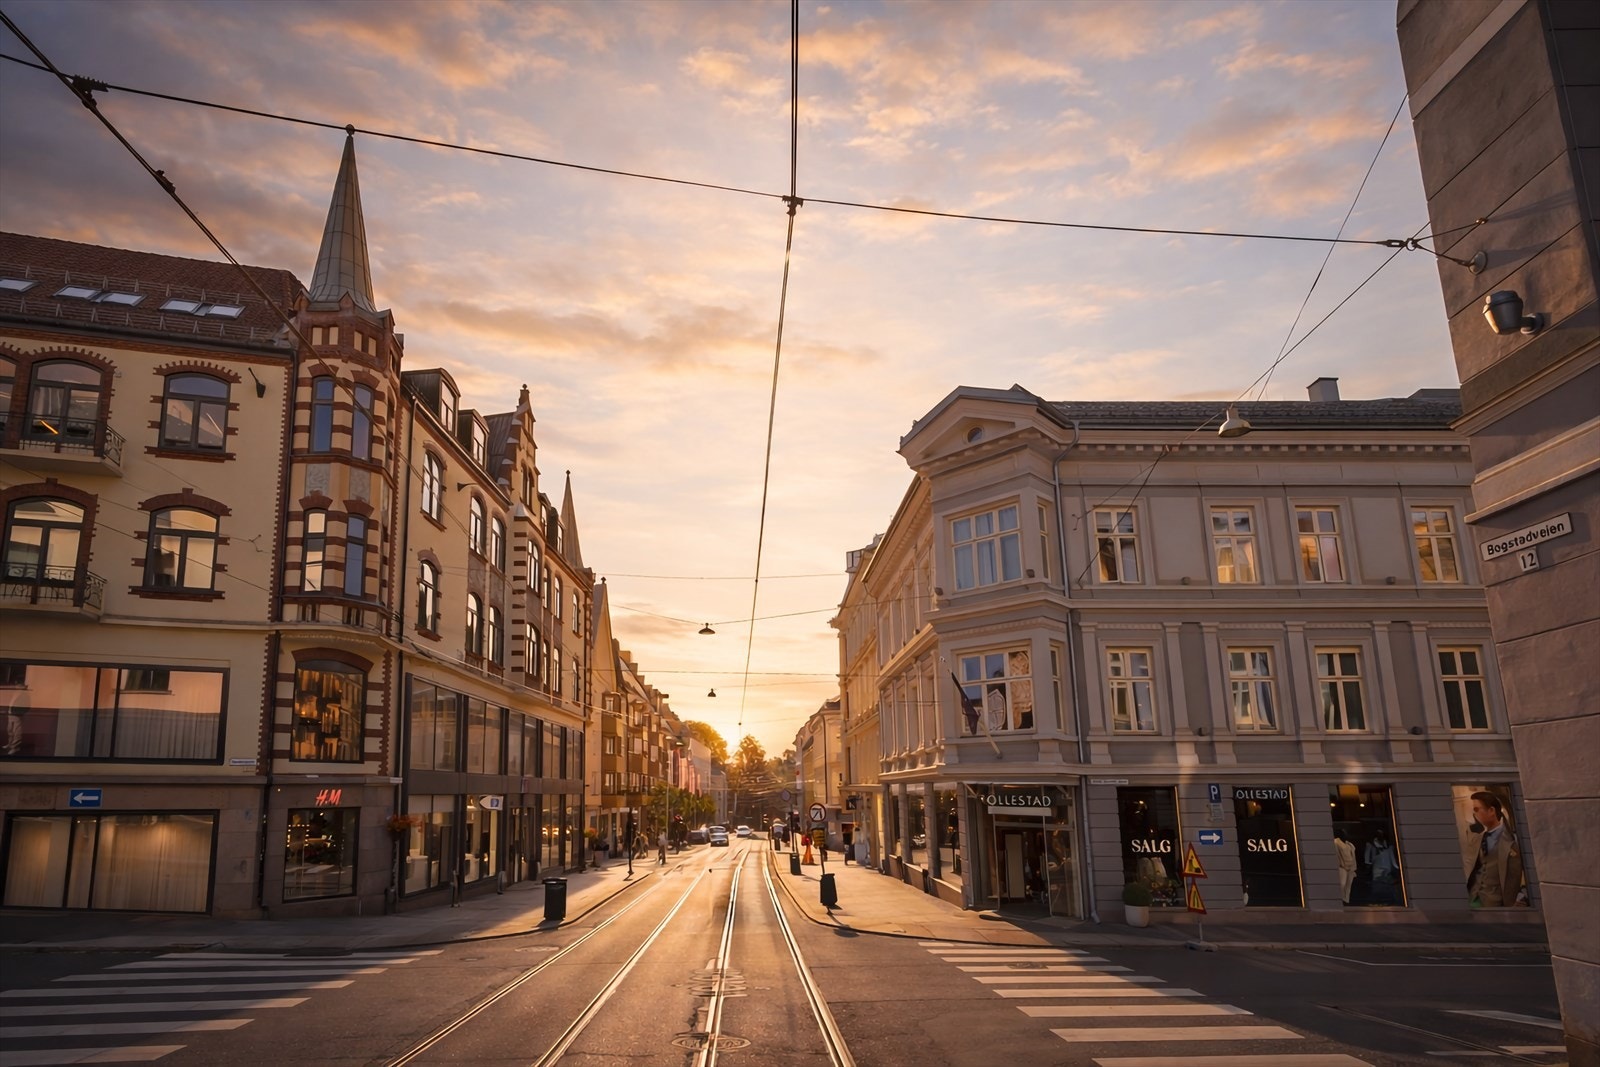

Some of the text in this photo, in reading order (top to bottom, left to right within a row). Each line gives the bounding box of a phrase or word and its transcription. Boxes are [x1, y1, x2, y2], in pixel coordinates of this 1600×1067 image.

[1487, 523, 1564, 555] Bogstadveien
[1521, 553, 1536, 569] 12
[1210, 785, 1218, 800] P
[986, 795, 1052, 807] OLLESTAD
[1131, 839, 1171, 853] SALG
[1247, 838, 1288, 852] SALG
